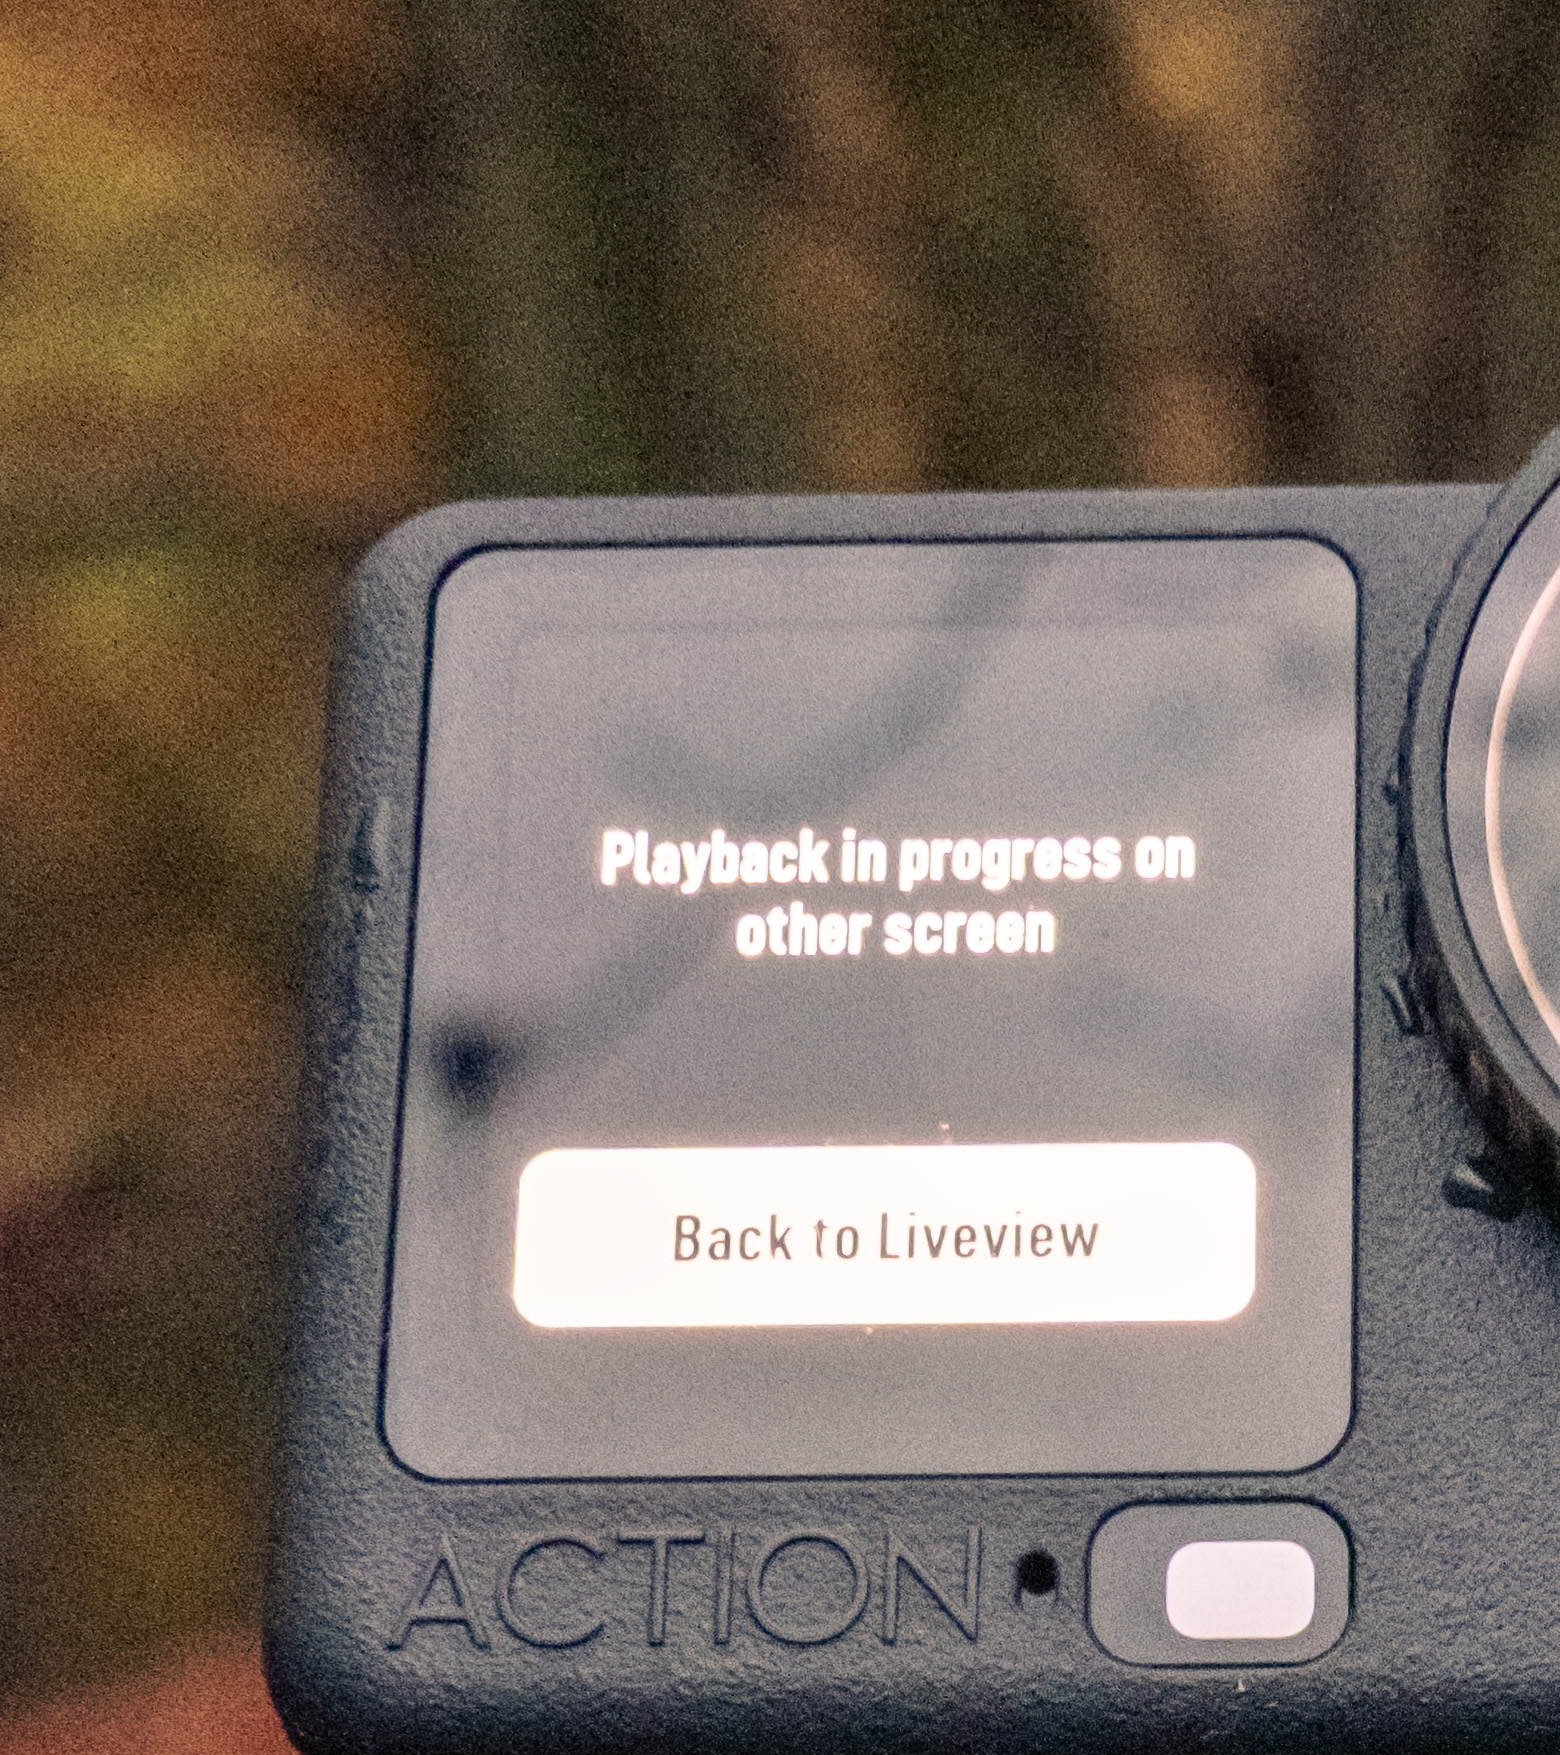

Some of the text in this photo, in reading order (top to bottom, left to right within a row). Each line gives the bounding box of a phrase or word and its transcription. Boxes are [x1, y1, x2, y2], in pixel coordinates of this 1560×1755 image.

[600, 827, 1197, 895] Playback in progress on
[734, 901, 1058, 957] other screen
[673, 1210, 1101, 1262] Back to Liveview
[386, 1525, 983, 1652] ACTION
